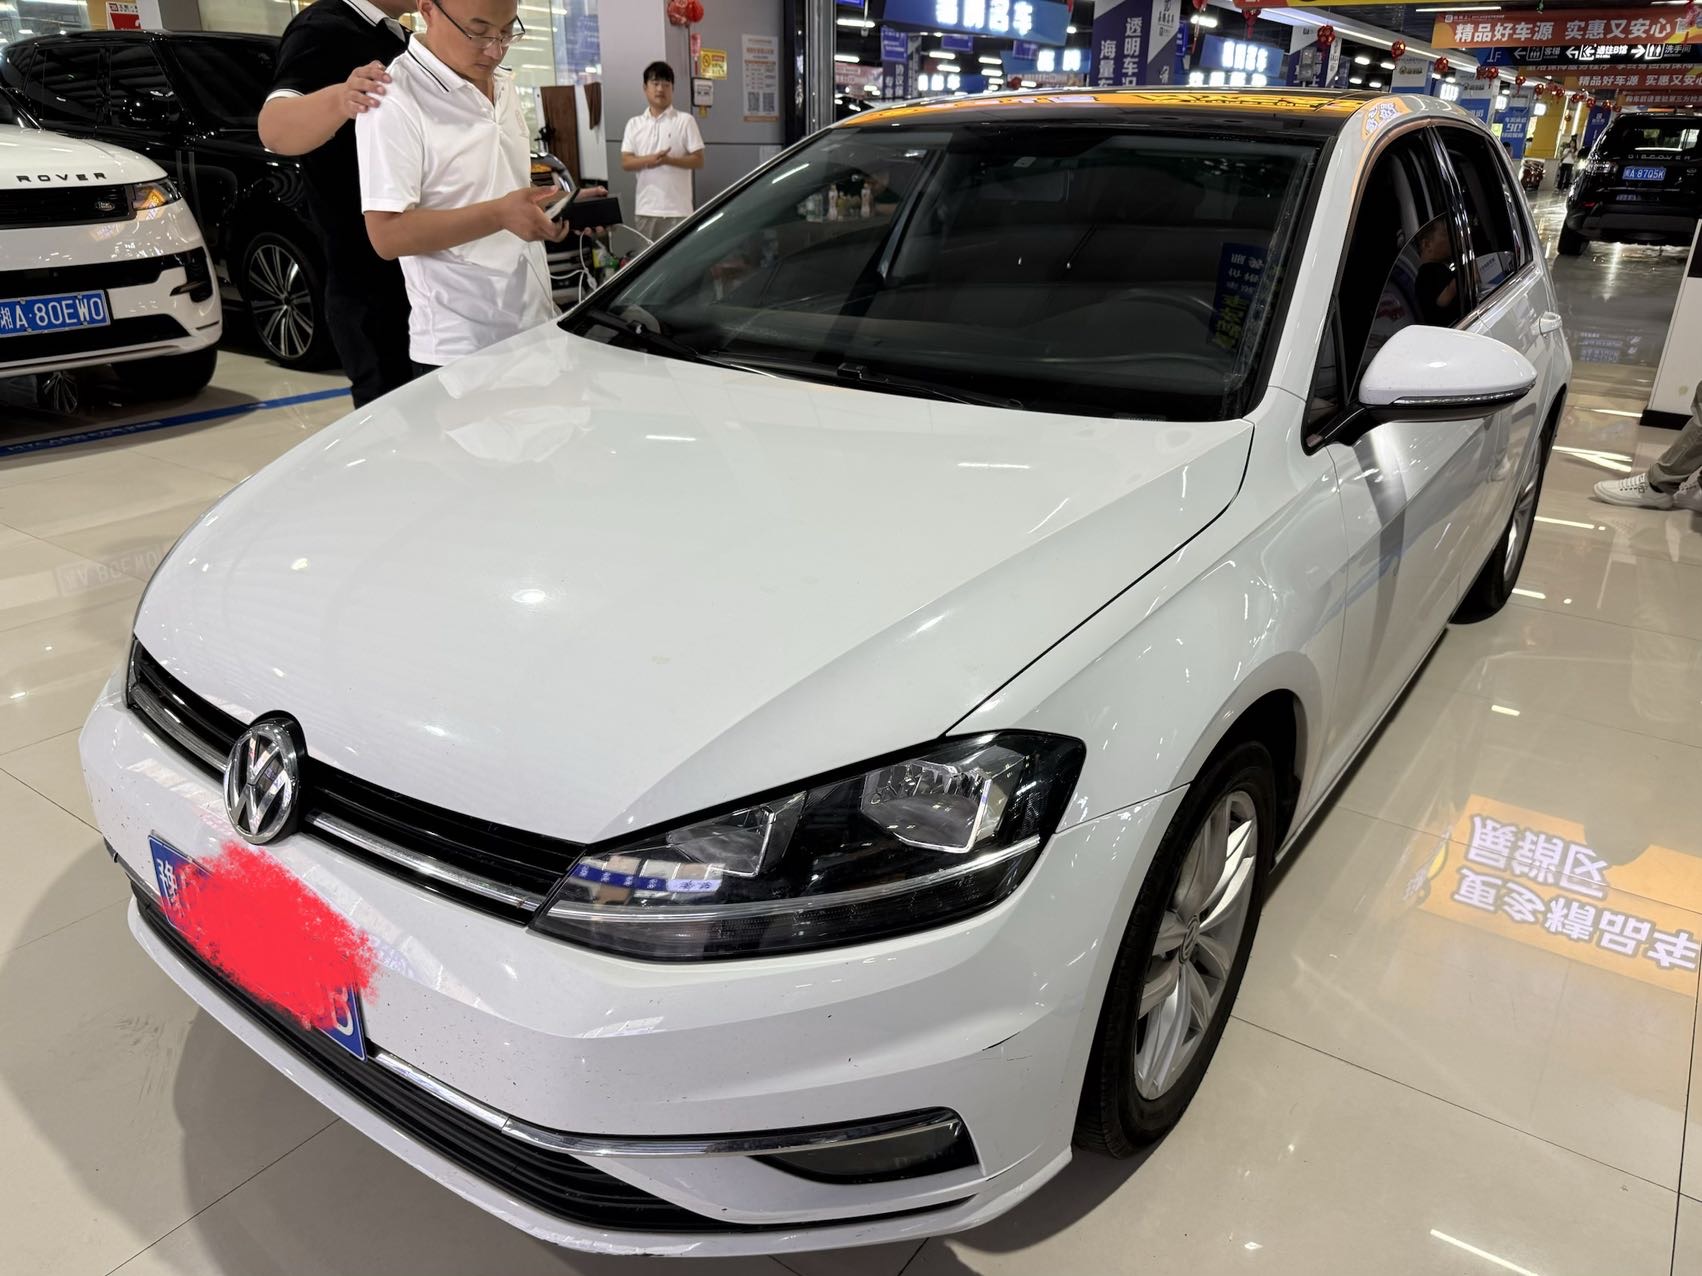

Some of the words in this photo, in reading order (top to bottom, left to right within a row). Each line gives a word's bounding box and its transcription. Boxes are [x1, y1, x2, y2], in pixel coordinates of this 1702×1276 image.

[1454, 21, 1555, 43] 精品好车源
[1564, 18, 1671, 40] 实惠又安心
[1578, 75, 1640, 86] 精品好车源
[16, 172, 107, 183] ROVER
